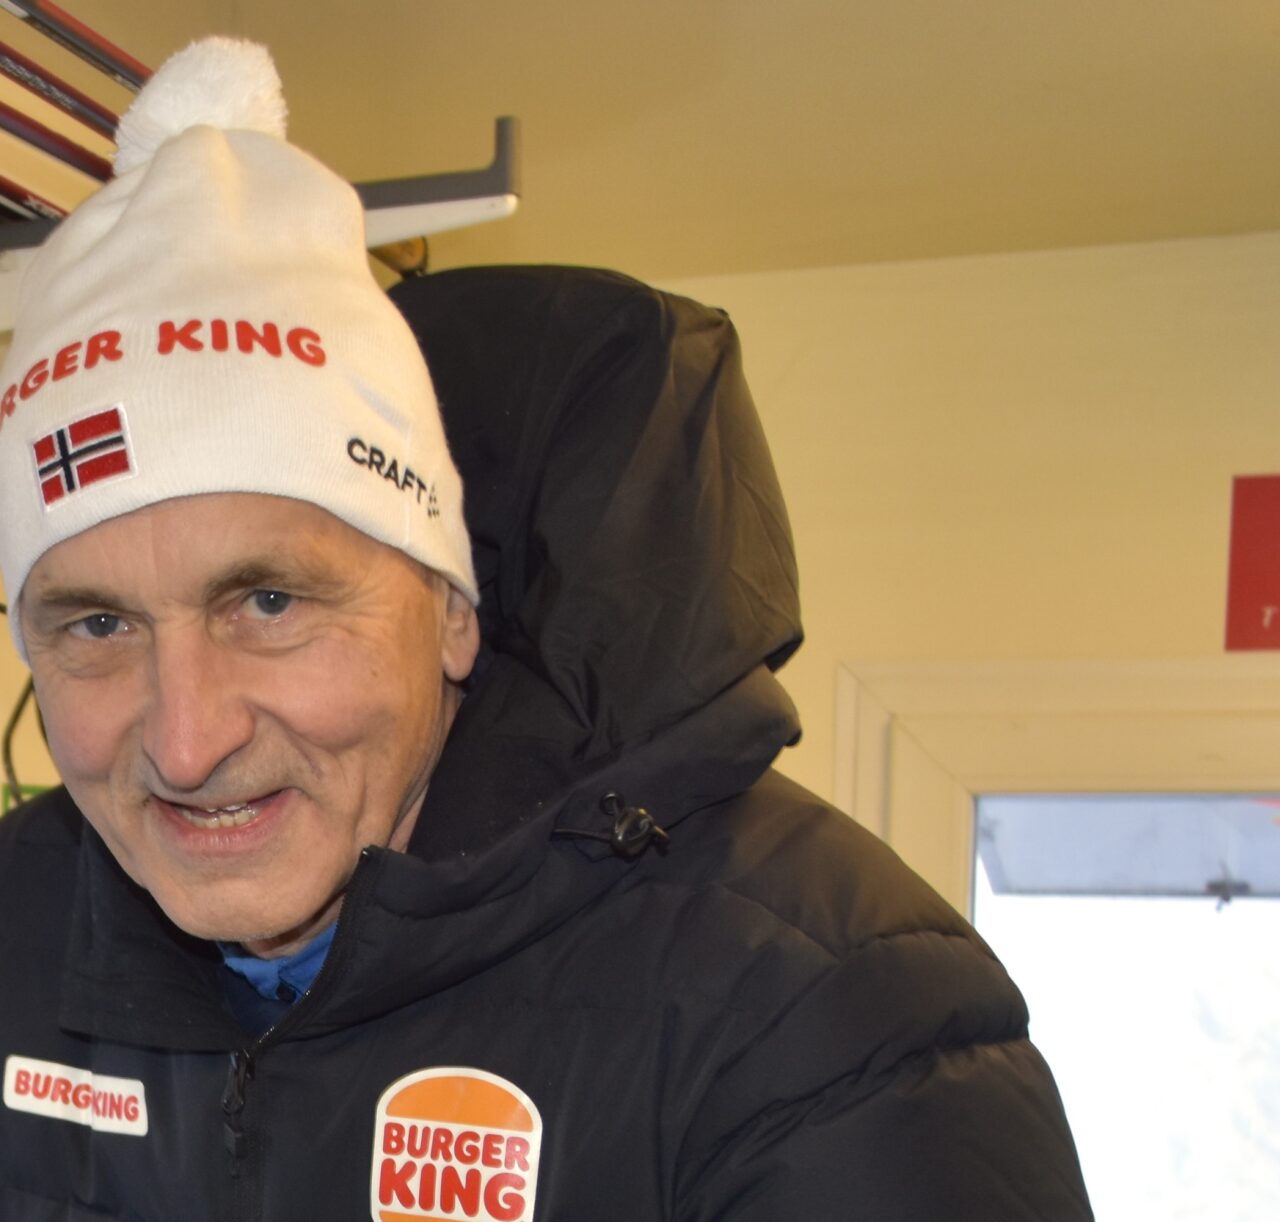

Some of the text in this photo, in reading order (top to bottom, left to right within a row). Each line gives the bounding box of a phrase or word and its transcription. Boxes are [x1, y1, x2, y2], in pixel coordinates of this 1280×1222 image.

[158, 319, 327, 367] KING
[347, 437, 428, 504] CRAFT
[382, 1122, 531, 1172] BURGER
[379, 1158, 526, 1222] KING
